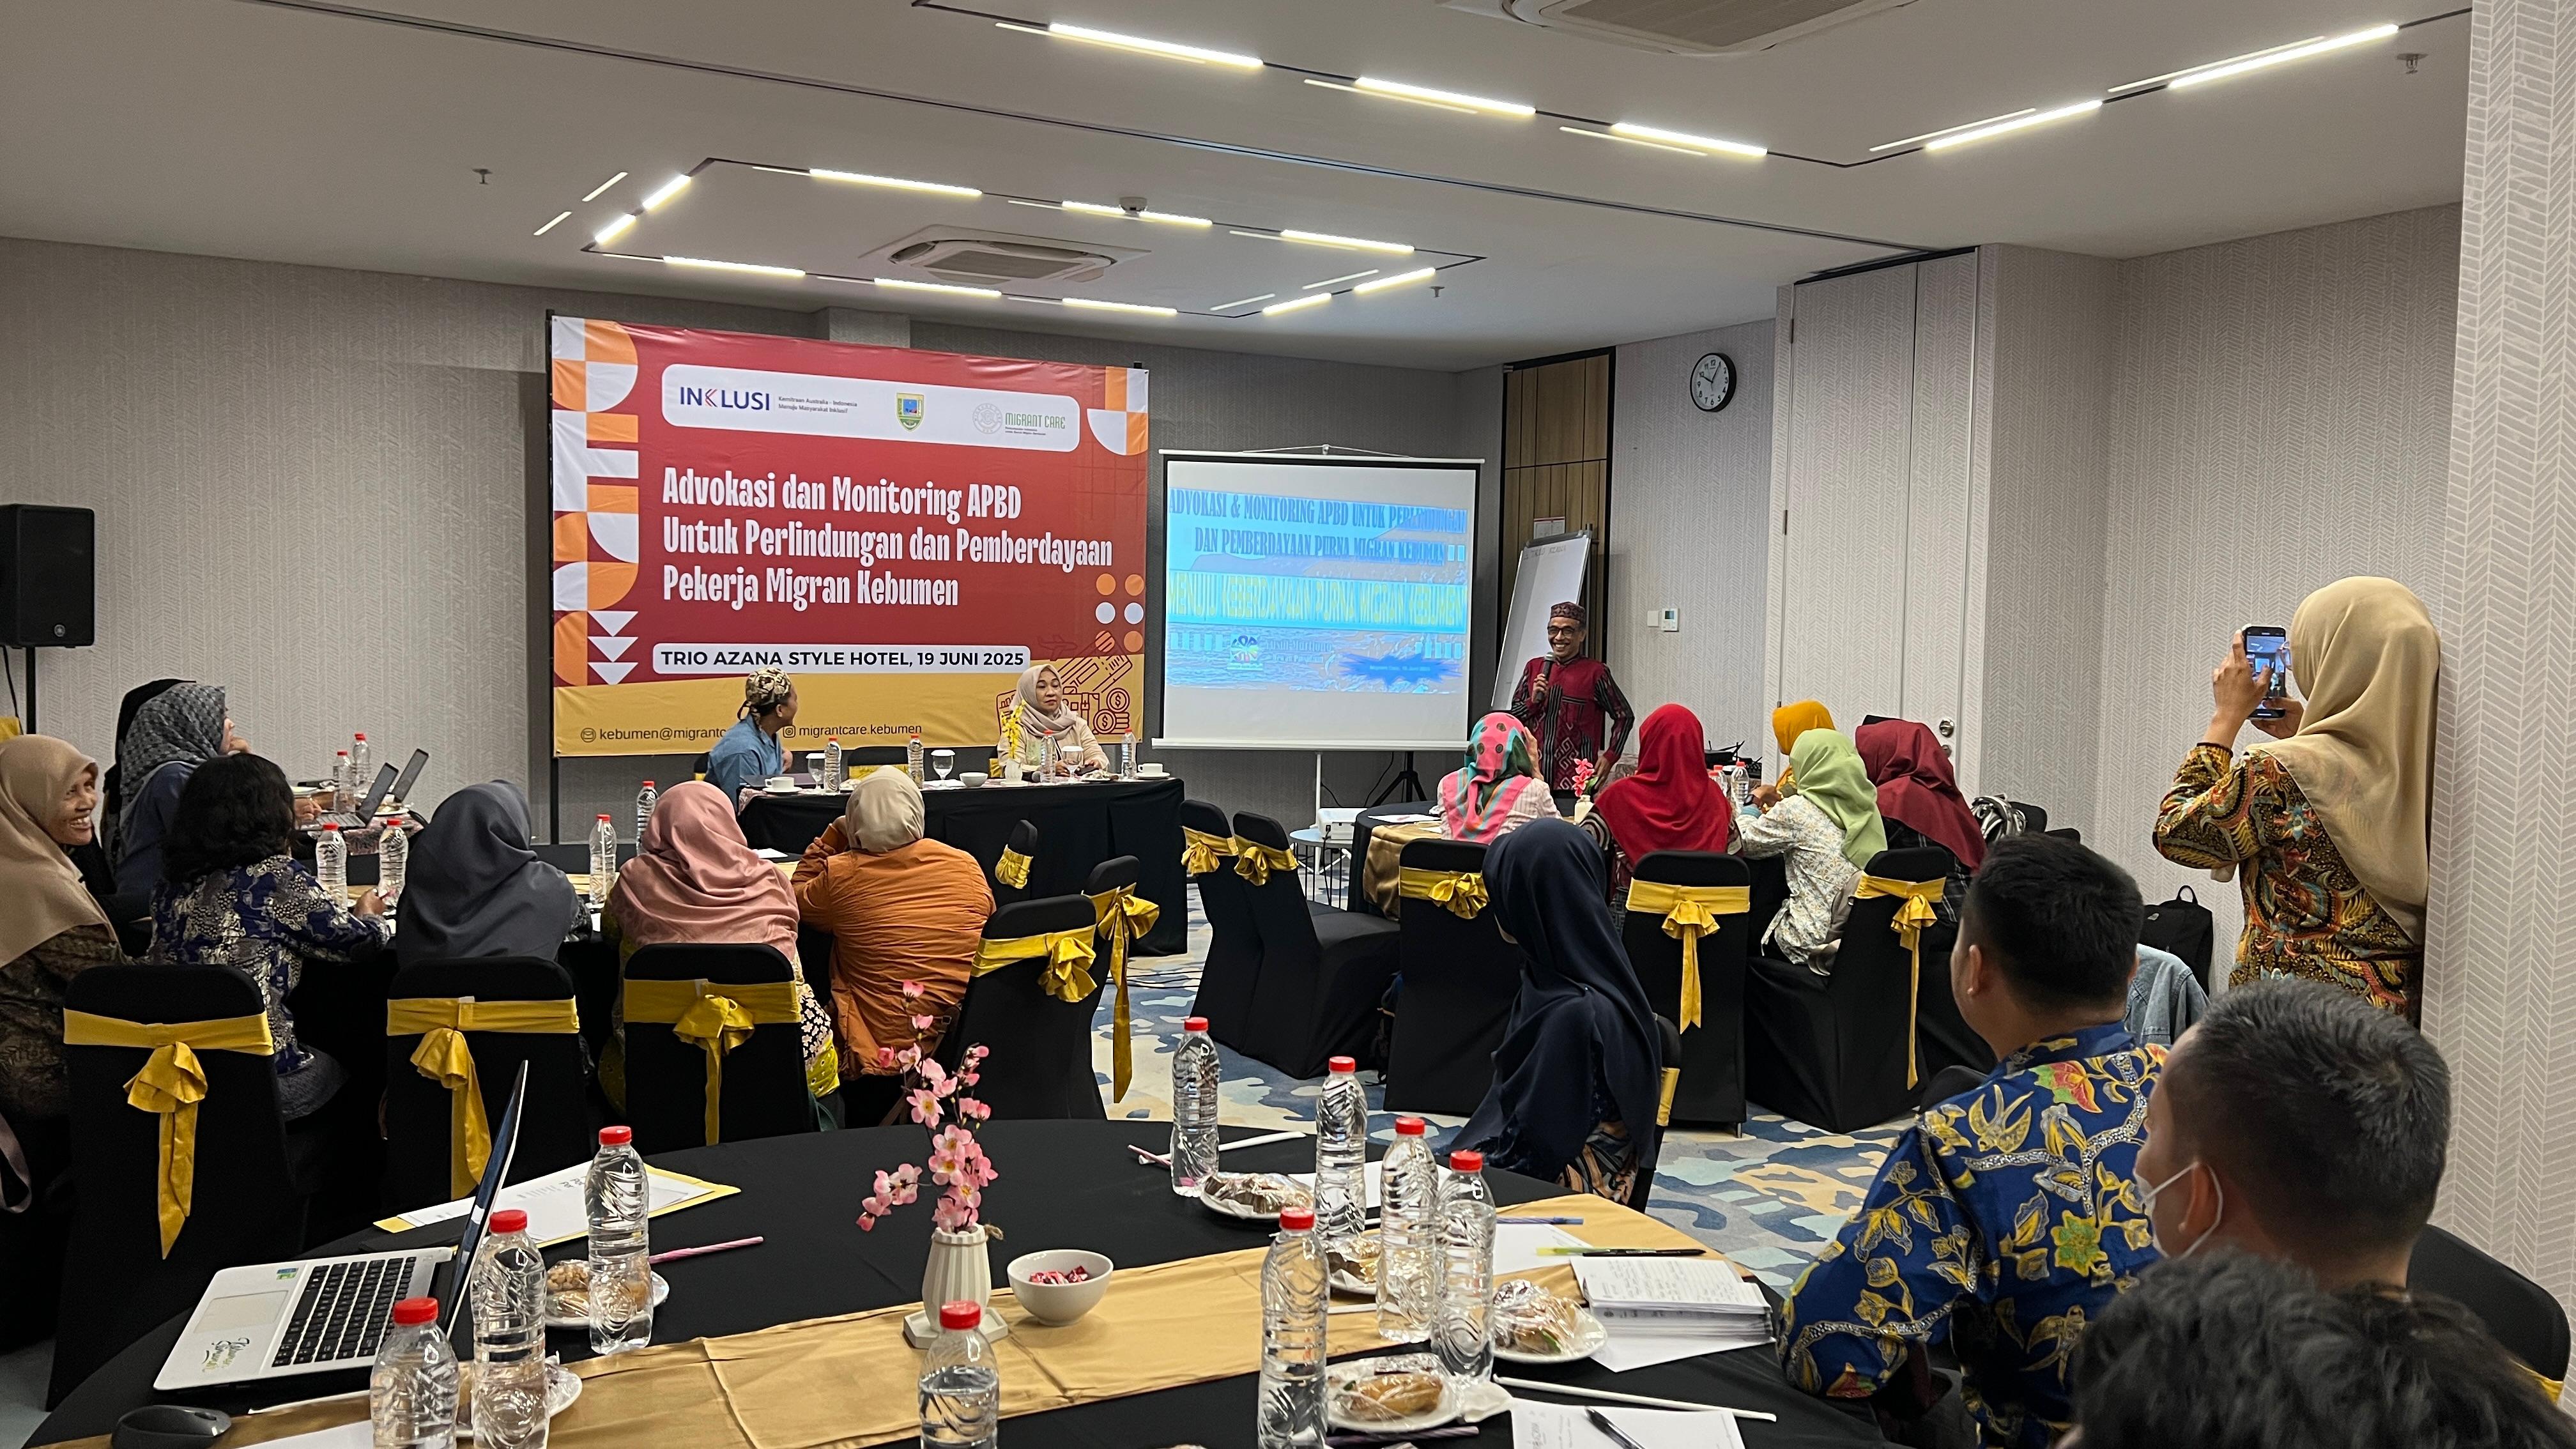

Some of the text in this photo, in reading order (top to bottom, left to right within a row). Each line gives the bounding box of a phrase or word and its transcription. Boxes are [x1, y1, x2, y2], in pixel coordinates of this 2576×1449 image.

[680, 387, 770, 411] INKLUSI
[1005, 413, 1042, 427] MIGRANT
[1045, 415, 1066, 429] CARE
[663, 468, 1022, 525] Advokasi dan Monitoring APBD
[1169, 488, 1227, 518] ADVOKASI
[1231, 494, 1240, 519] &
[1244, 495, 1315, 525] MONITORING
[1317, 500, 1349, 526] APBD
[1353, 503, 1385, 528] UNTUK
[663, 516, 1112, 573] Untuk Perlindungan dan Pemberdayaan
[1195, 527, 1218, 553] DAN
[1222, 528, 1312, 556] PEMBERDAYAAN
[1315, 535, 1350, 558] PURNA
[1354, 537, 1395, 562] MIGRAN
[664, 565, 958, 611] Pekerja Migran Kebumen
[1168, 571, 1467, 627] MENUJU KEBERDAYAAN PURNA MIGRAN KEBUMEN
[661, 651, 1023, 668] TRIO AZANA STYLE HOTEL, 19 JUNI 2025
[799, 724, 922, 739] migrantcare.kebumen
